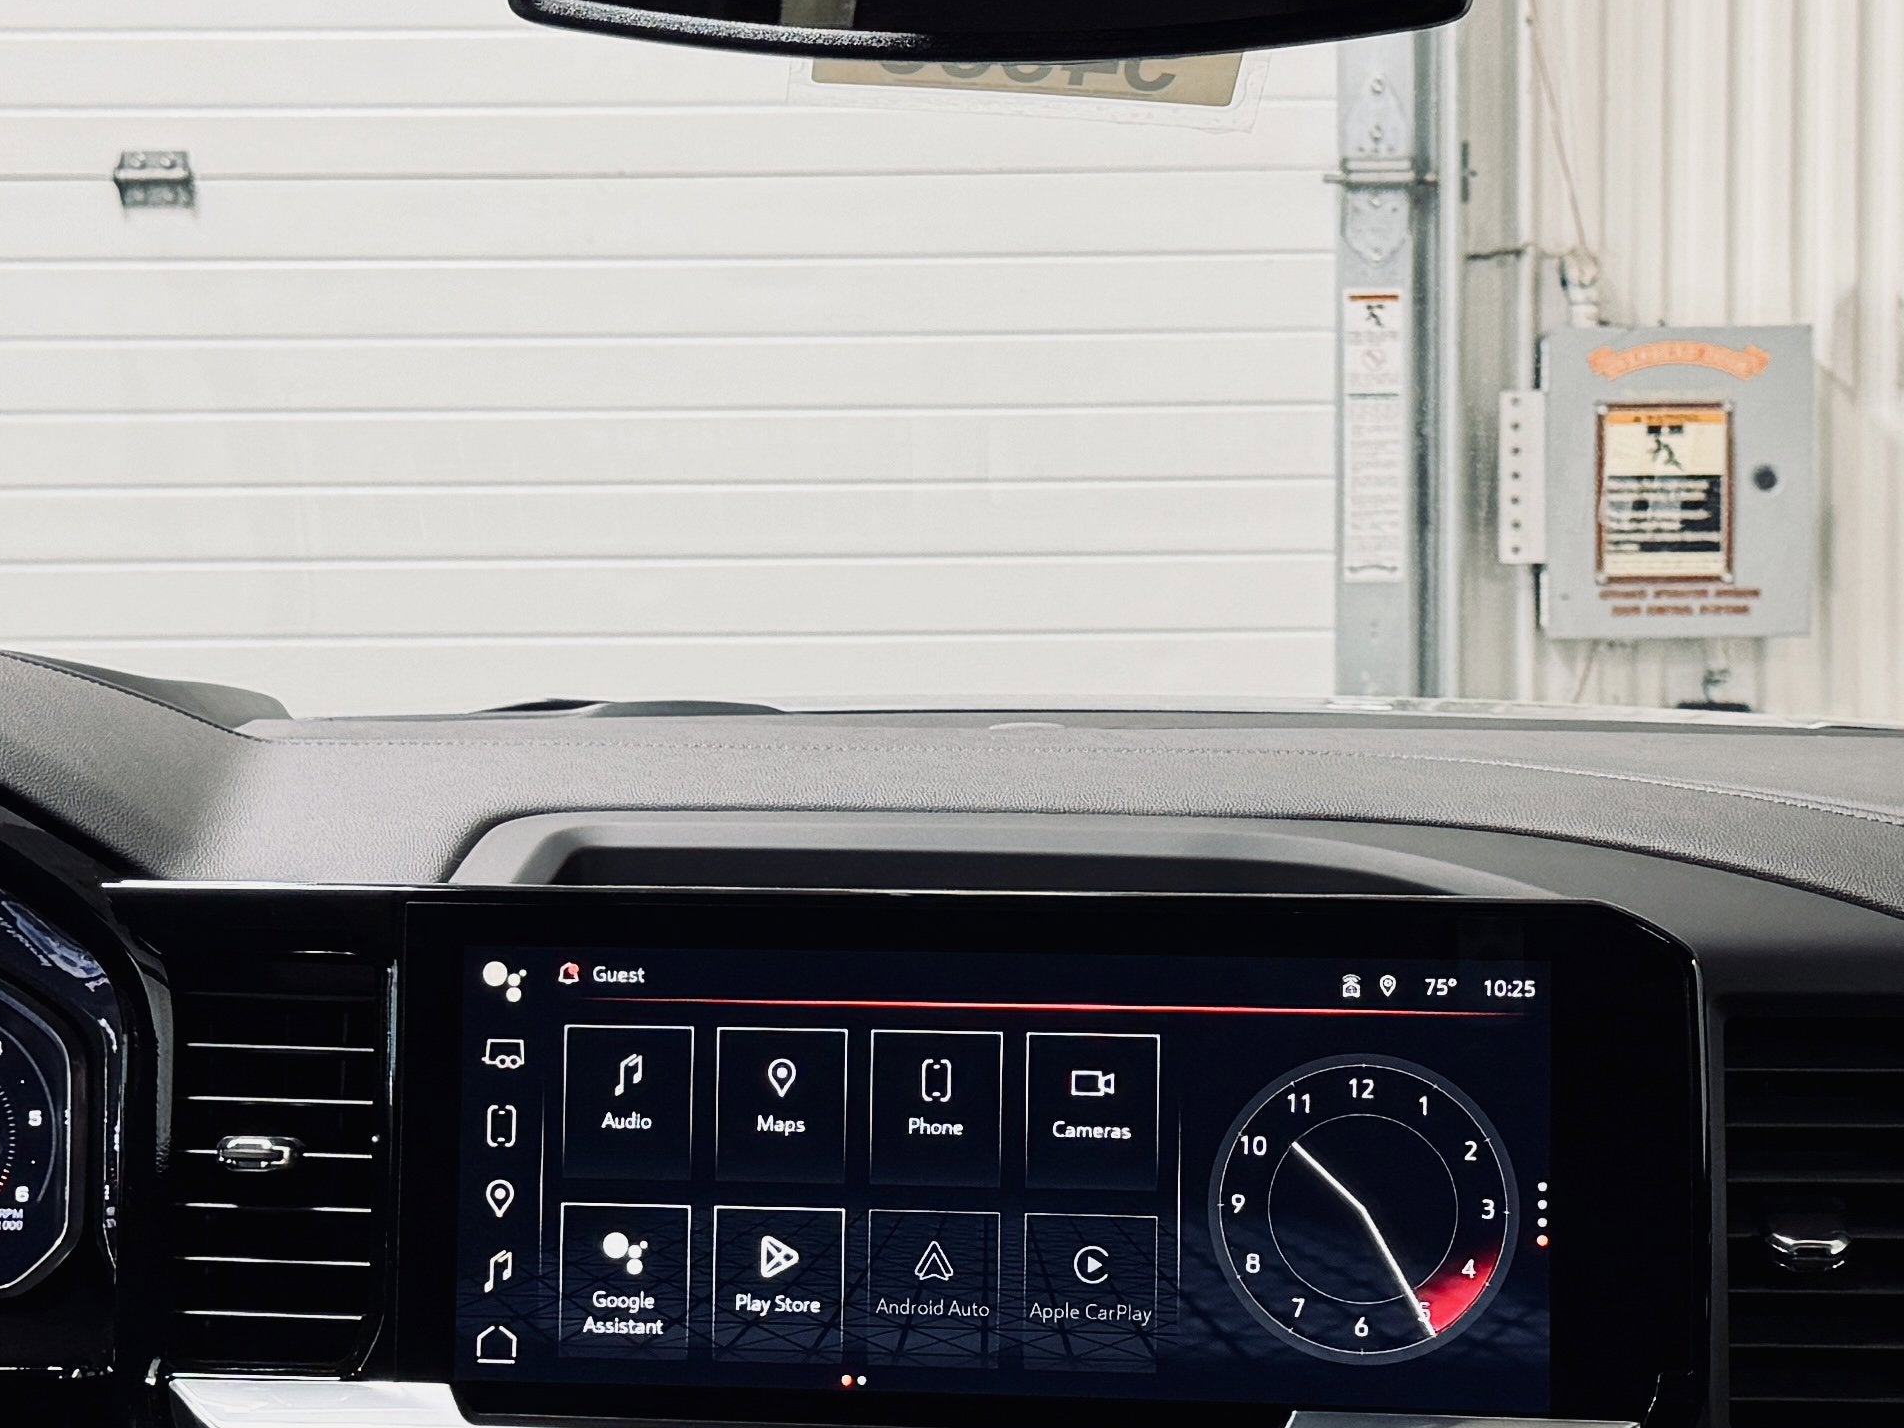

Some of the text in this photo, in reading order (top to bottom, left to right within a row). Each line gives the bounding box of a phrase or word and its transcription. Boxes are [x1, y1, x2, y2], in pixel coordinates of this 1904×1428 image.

[592, 966, 646, 985] Guest
[1425, 978, 1536, 998] 75° 10:25
[1349, 1079, 1375, 1099] 12
[1287, 1094, 1311, 1113] 11
[1419, 1096, 1429, 1115] 1
[28, 1110, 43, 1126] 5
[601, 1112, 652, 1131] Audio
[756, 1115, 806, 1136] Maps
[908, 1118, 964, 1136] Phone
[1052, 1121, 1132, 1140] Cameras
[1240, 1135, 1267, 1156] 10
[1463, 1141, 1477, 1161] 2
[15, 1186, 29, 1203] 6
[1231, 1193, 1245, 1214] 9
[1481, 1199, 1496, 1220] 3
[1245, 1253, 1261, 1274] 8
[1461, 1259, 1476, 1279] 4
[592, 1292, 655, 1312] Google
[735, 1295, 821, 1316] Play Store
[876, 1298, 990, 1318] Android Auto
[1292, 1299, 1305, 1319] 7
[1029, 1303, 1152, 1325] Apple CarPlay
[583, 1317, 664, 1336] Assistant
[1354, 1317, 1369, 1338] 6
